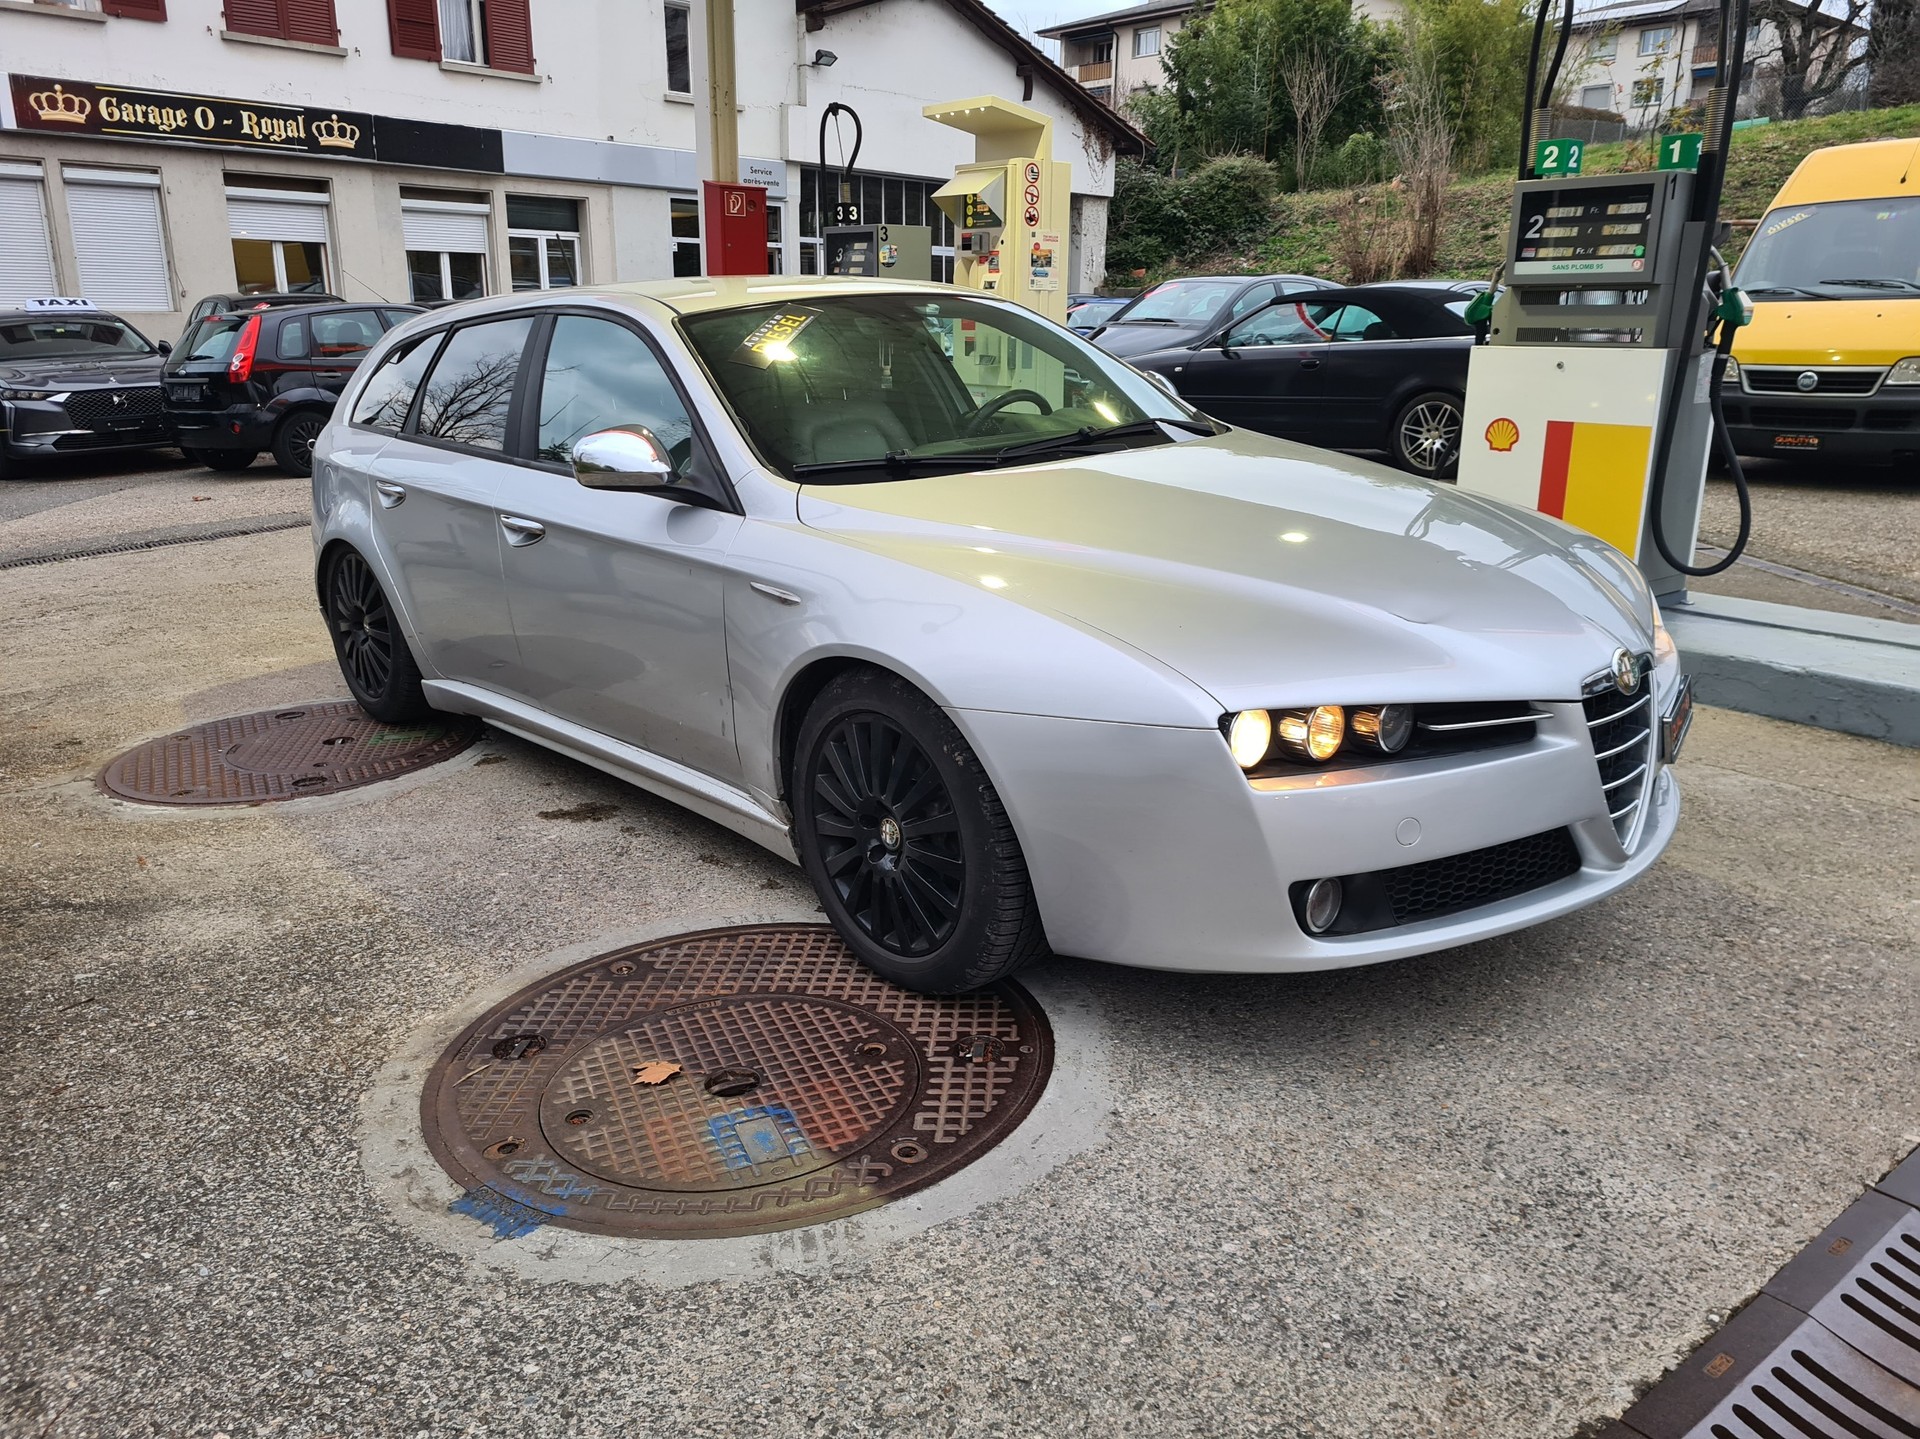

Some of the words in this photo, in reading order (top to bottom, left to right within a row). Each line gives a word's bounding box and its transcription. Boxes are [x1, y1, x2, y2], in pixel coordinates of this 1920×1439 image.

[98, 96, 188, 132] Garage
[194, 106, 216, 131] O
[240, 110, 306, 142] Royal
[1542, 145, 1559, 169] 2
[1568, 145, 1579, 168] 2
[1669, 139, 1682, 164] 1
[750, 166, 773, 176] Service
[1670, 174, 1677, 200] 1
[836, 206, 843, 220] 3
[849, 206, 858, 220] 3
[880, 226, 889, 242] 3
[1524, 214, 1544, 238] 2
[836, 248, 844, 262] 3
